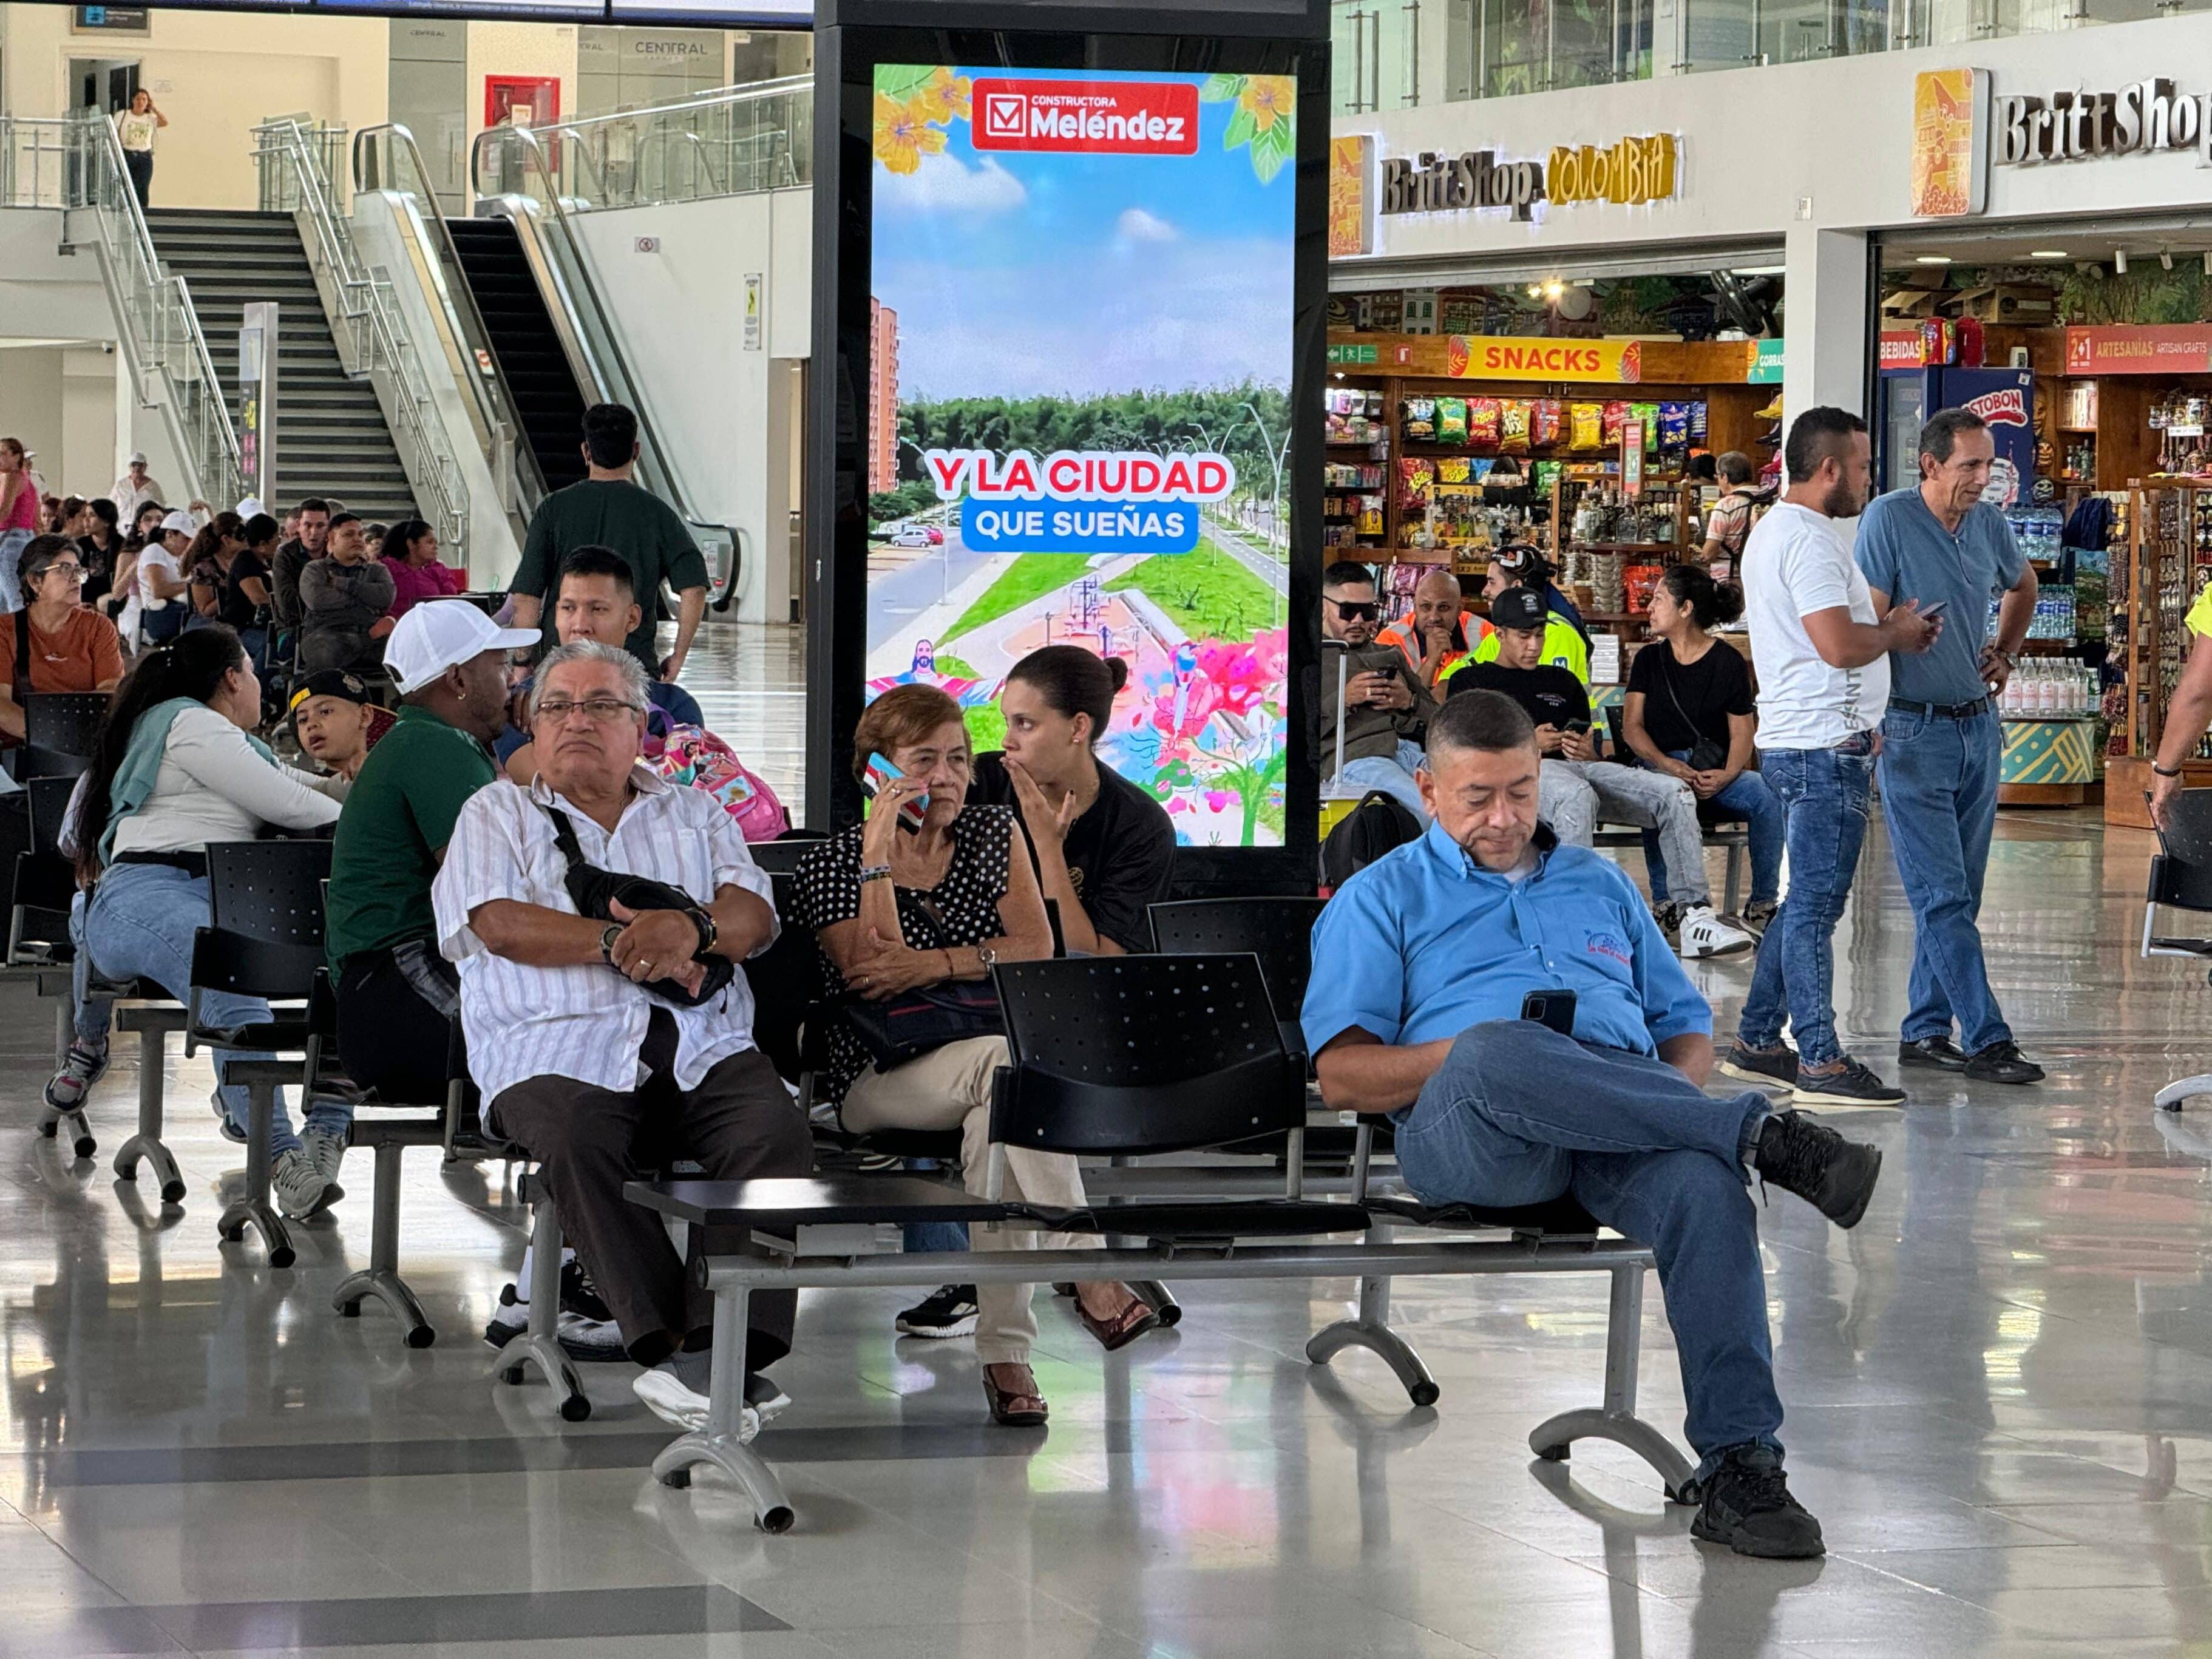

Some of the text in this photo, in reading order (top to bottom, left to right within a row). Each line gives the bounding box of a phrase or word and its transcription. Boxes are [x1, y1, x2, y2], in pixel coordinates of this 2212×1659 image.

[1031, 95, 1117, 108] CONSTRUCTORA
[1030, 107, 1184, 142] Meléndez
[1484, 346, 1601, 373] SNACKS
[1880, 341, 1921, 360] BEBIDAS
[2096, 338, 2153, 358] ARTESANÍAS
[1963, 390, 2021, 415] STOBON
[933, 456, 1228, 494] Y LA CIUDAD
[975, 504, 1185, 543] QUE SUEÑAS
